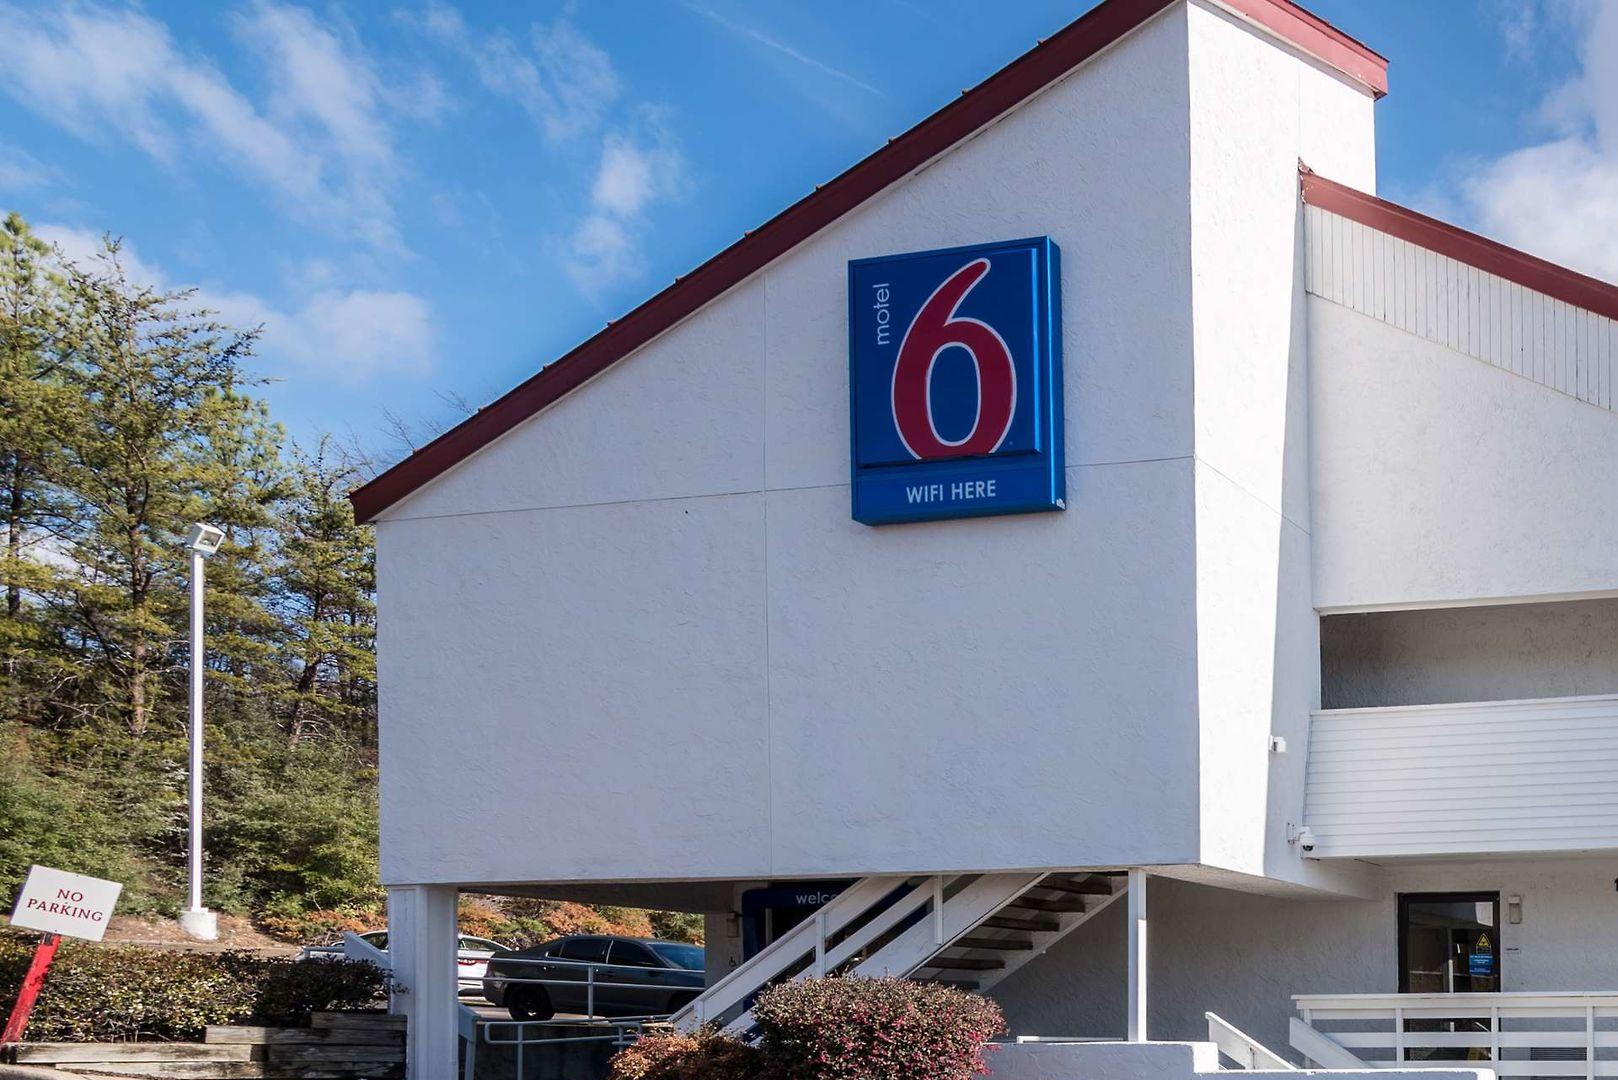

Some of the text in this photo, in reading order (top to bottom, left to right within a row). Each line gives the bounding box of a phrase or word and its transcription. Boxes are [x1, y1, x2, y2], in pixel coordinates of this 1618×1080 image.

[872, 282, 890, 345] motel
[891, 257, 1017, 460] 6
[906, 480, 996, 504] WIFI HERE
[57, 888, 83, 902] NO
[27, 898, 103, 921] PARKING
